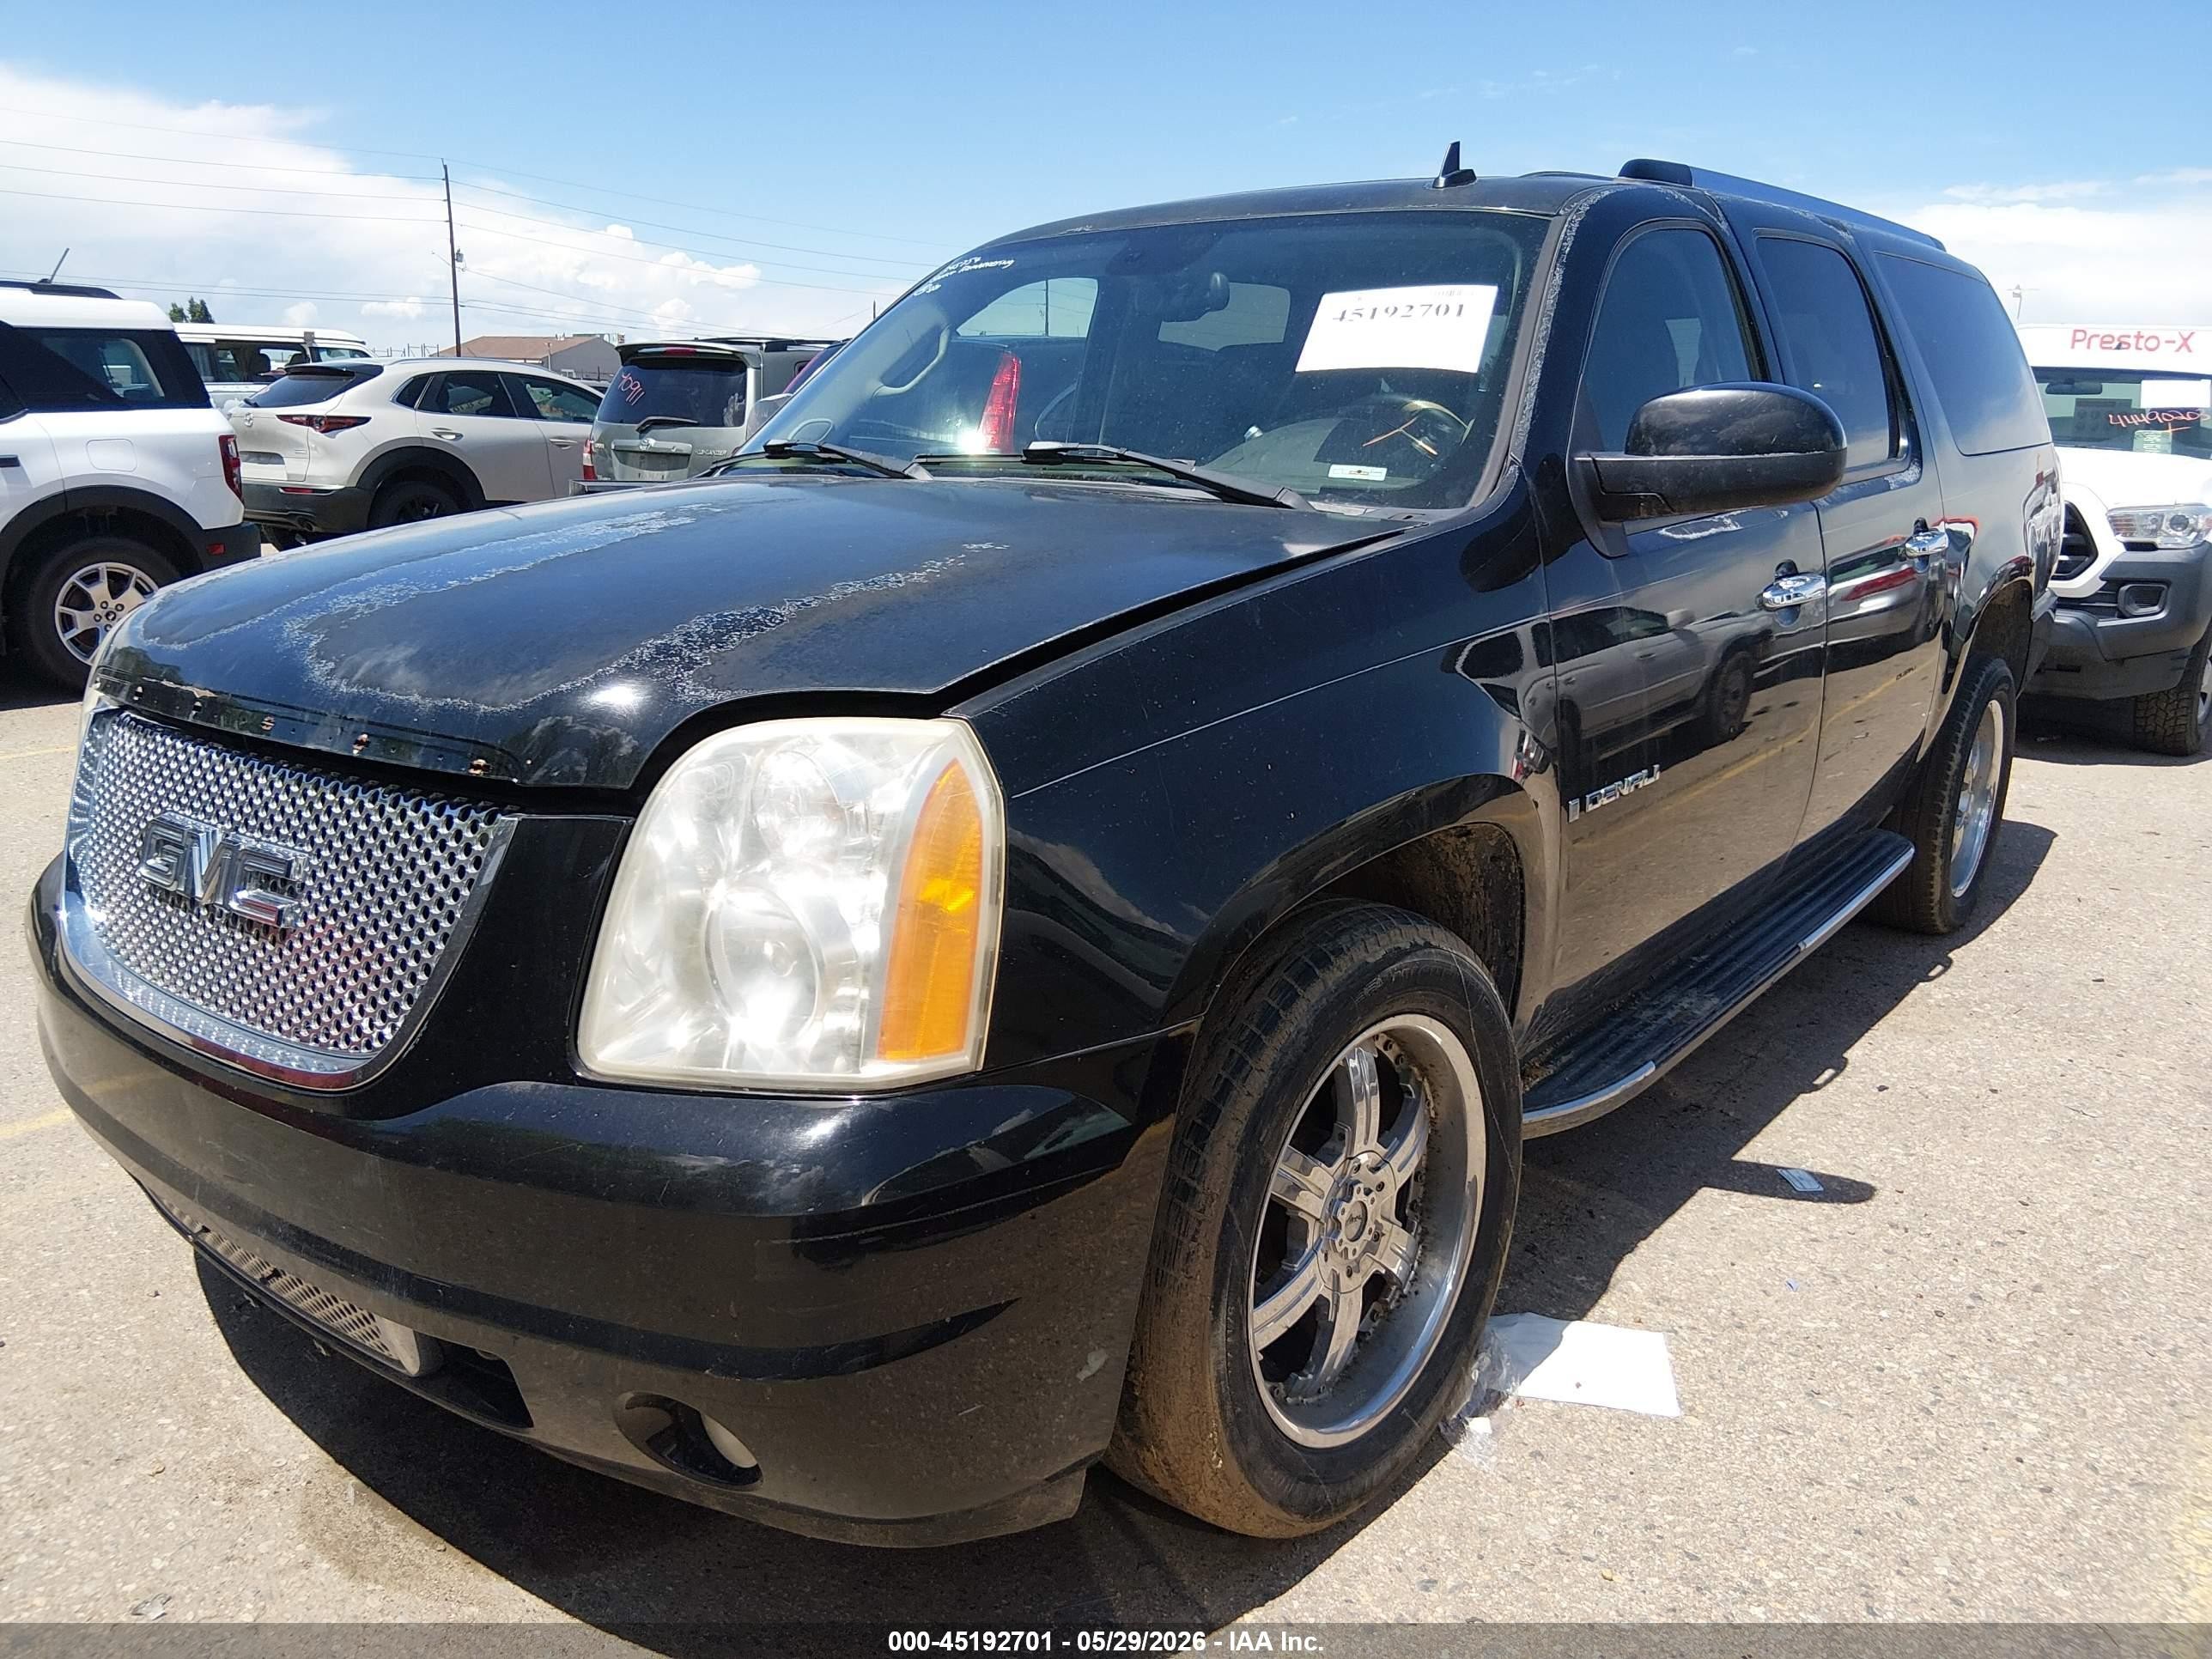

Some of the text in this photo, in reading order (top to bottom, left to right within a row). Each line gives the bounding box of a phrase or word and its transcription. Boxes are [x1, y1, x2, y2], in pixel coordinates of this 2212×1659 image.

[1332, 303, 1464, 322] 45192701
[2070, 329, 2197, 353] Presto-X
[1585, 763, 1661, 813] DENALI
[137, 811, 310, 928] GMC
